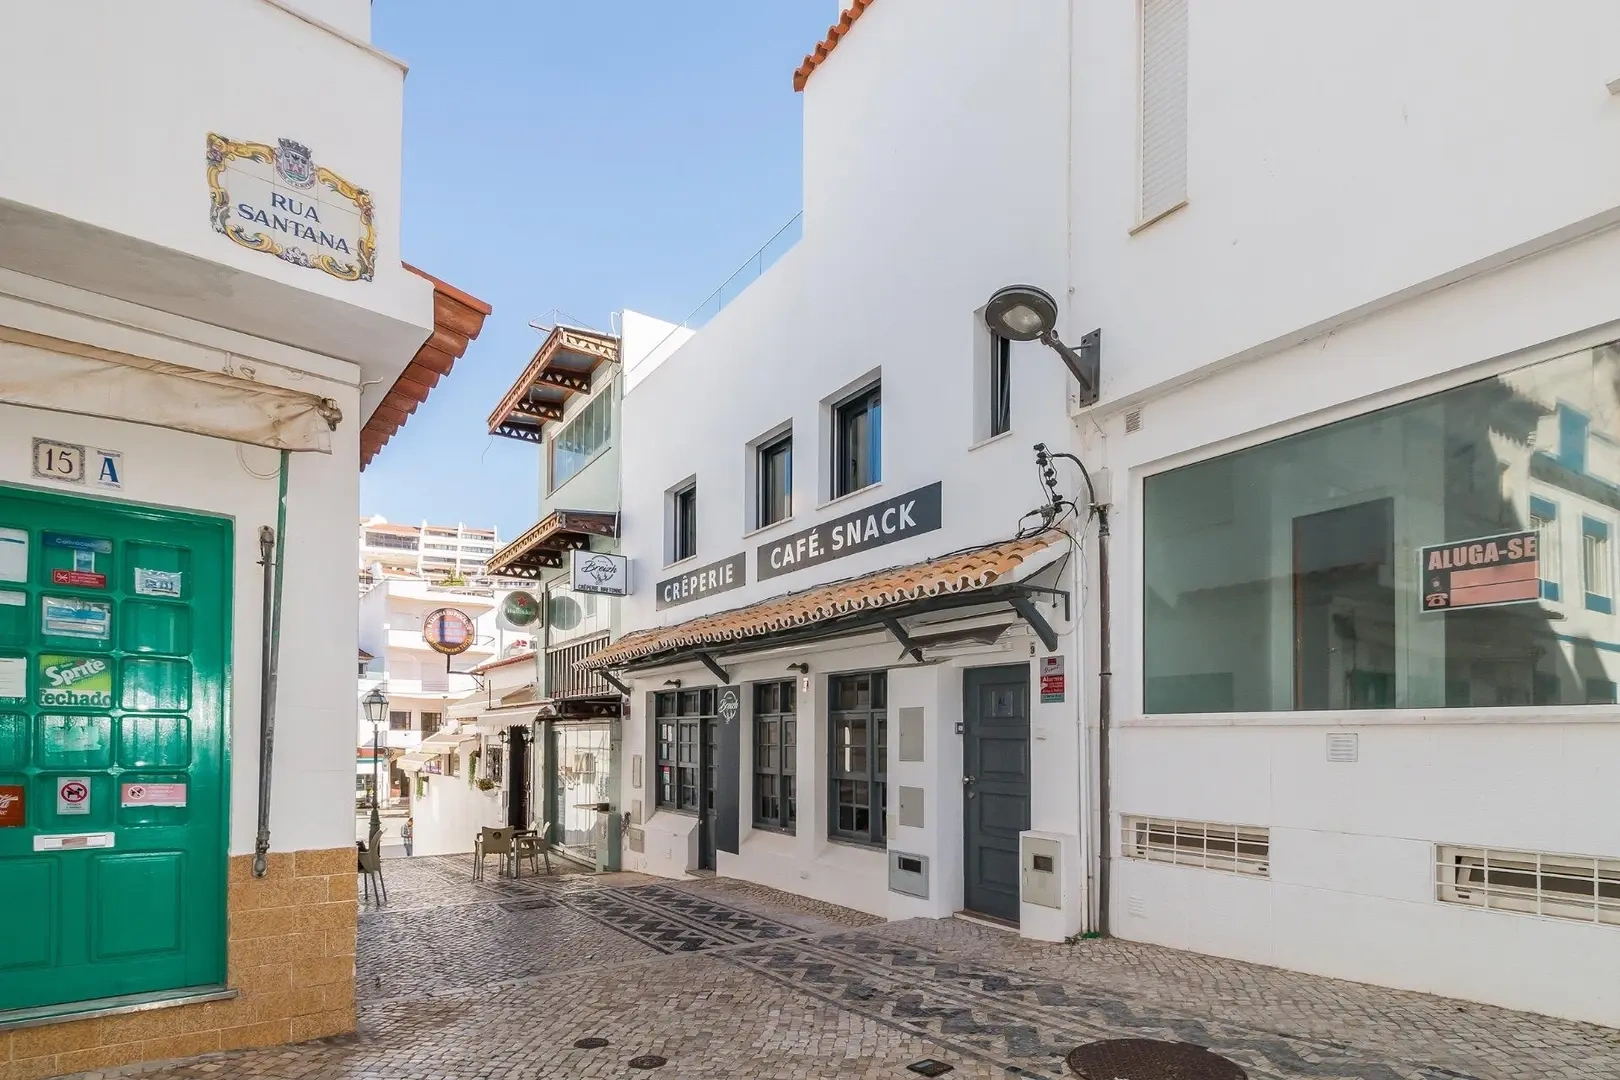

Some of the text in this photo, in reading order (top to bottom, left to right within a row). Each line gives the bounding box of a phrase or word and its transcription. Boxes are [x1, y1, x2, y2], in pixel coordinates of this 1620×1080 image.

[271, 192, 321, 223] RUA
[238, 203, 351, 255] SANTANA
[45, 448, 120, 483] 15 A
[832, 500, 917, 551] SNACK
[581, 560, 617, 573] Breizh
[1428, 536, 1537, 571] ALUGA-SE
[664, 562, 734, 603] CRÊPERIE
[45, 659, 106, 686] Sprite
